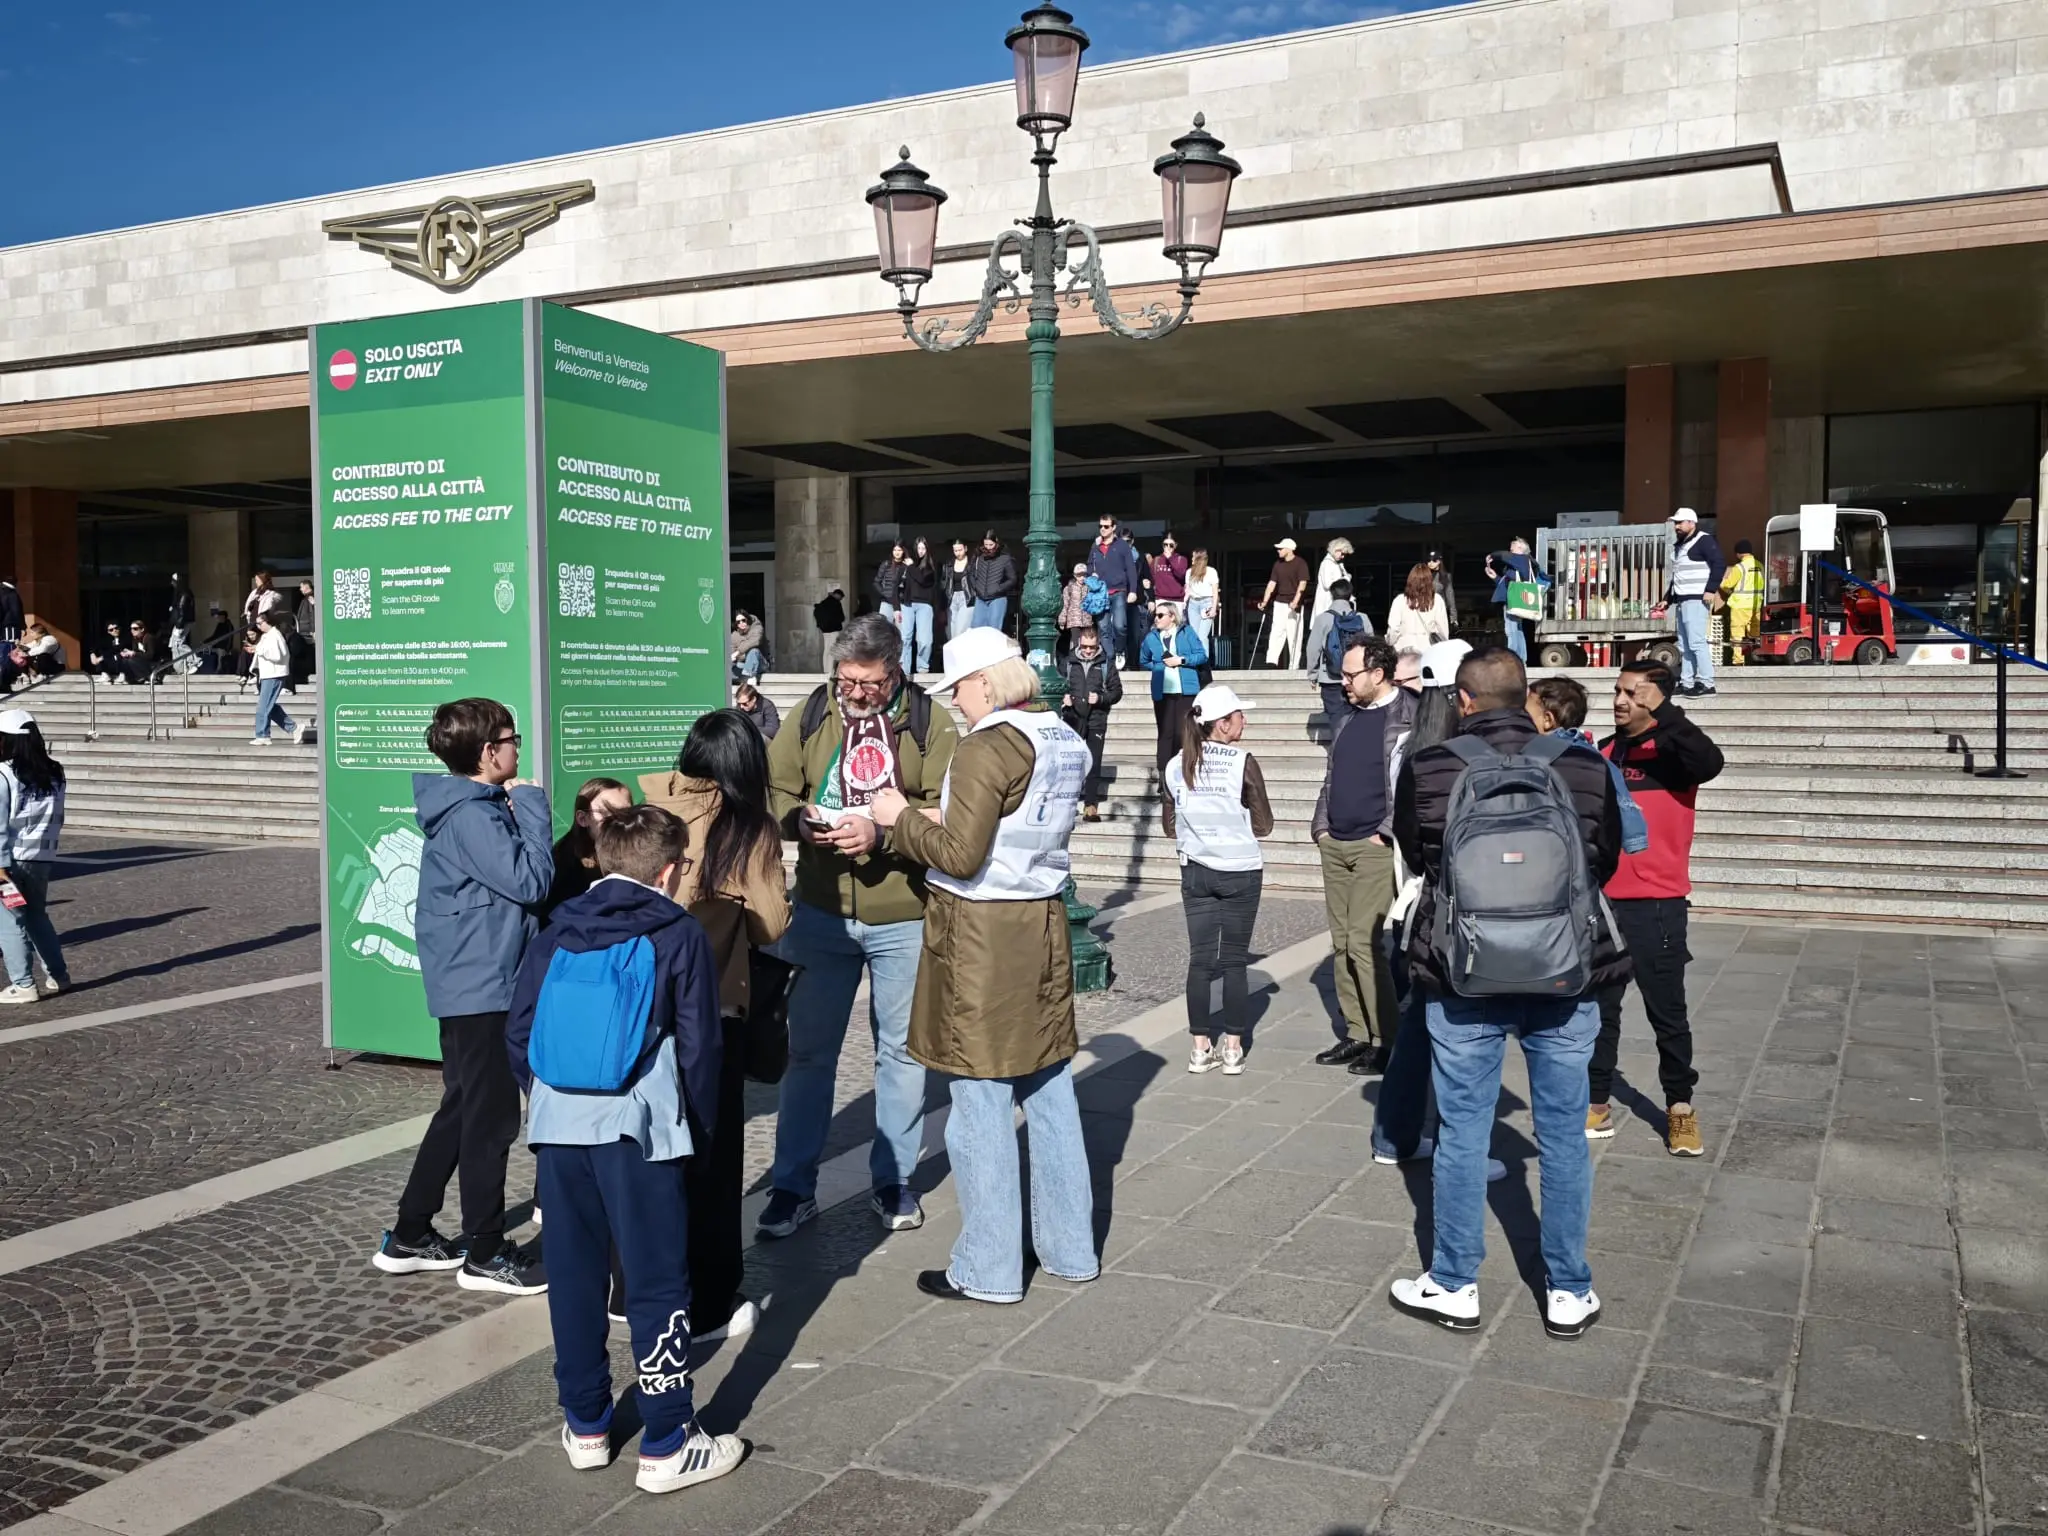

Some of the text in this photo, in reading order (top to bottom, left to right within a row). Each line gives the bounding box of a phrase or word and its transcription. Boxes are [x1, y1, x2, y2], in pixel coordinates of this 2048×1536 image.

[430, 212, 476, 270] FS
[365, 338, 462, 364] SOLO USCITA
[554, 338, 650, 374] Benvenuti a Venezia
[365, 361, 442, 384] EXIT ONLY
[554, 358, 648, 392] Welcome to Venice
[332, 459, 445, 481] CONTRIBUTO DI
[558, 456, 660, 486] CONTRIBUTO DI
[332, 476, 485, 502] ACCESSO ALLA CITTÀ
[558, 479, 692, 512] ACCESSO ALLA CITTÀ
[332, 505, 513, 530] ACCESS FEE TO THE CITY
[558, 508, 712, 541] ACCESS FEE TO THE CITY
[381, 564, 451, 577] Inquadra il QR code
[604, 568, 634, 578] Inquadra
[634, 570, 639, 579] il
[640, 572, 649, 580] QR
[381, 577, 444, 590] per saperne di più
[604, 581, 616, 590] per
[617, 582, 642, 591] saperne
[382, 596, 399, 604] Scan
[422, 594, 440, 602] code
[605, 596, 657, 608] Scan the QR code
[390, 607, 406, 615] learn
[606, 609, 612, 617] to
[613, 609, 628, 617] learn
[438, 640, 450, 648] alle
[450, 640, 471, 650] 16:00,
[346, 653, 364, 662] giorni
[571, 652, 589, 661] giorni
[590, 652, 612, 660] indicati
[336, 679, 348, 687] only
[369, 678, 382, 687] days
[561, 679, 573, 687] only
[593, 679, 606, 688] days
[864, 738, 888, 755] PAULI
[847, 794, 861, 806] FC
